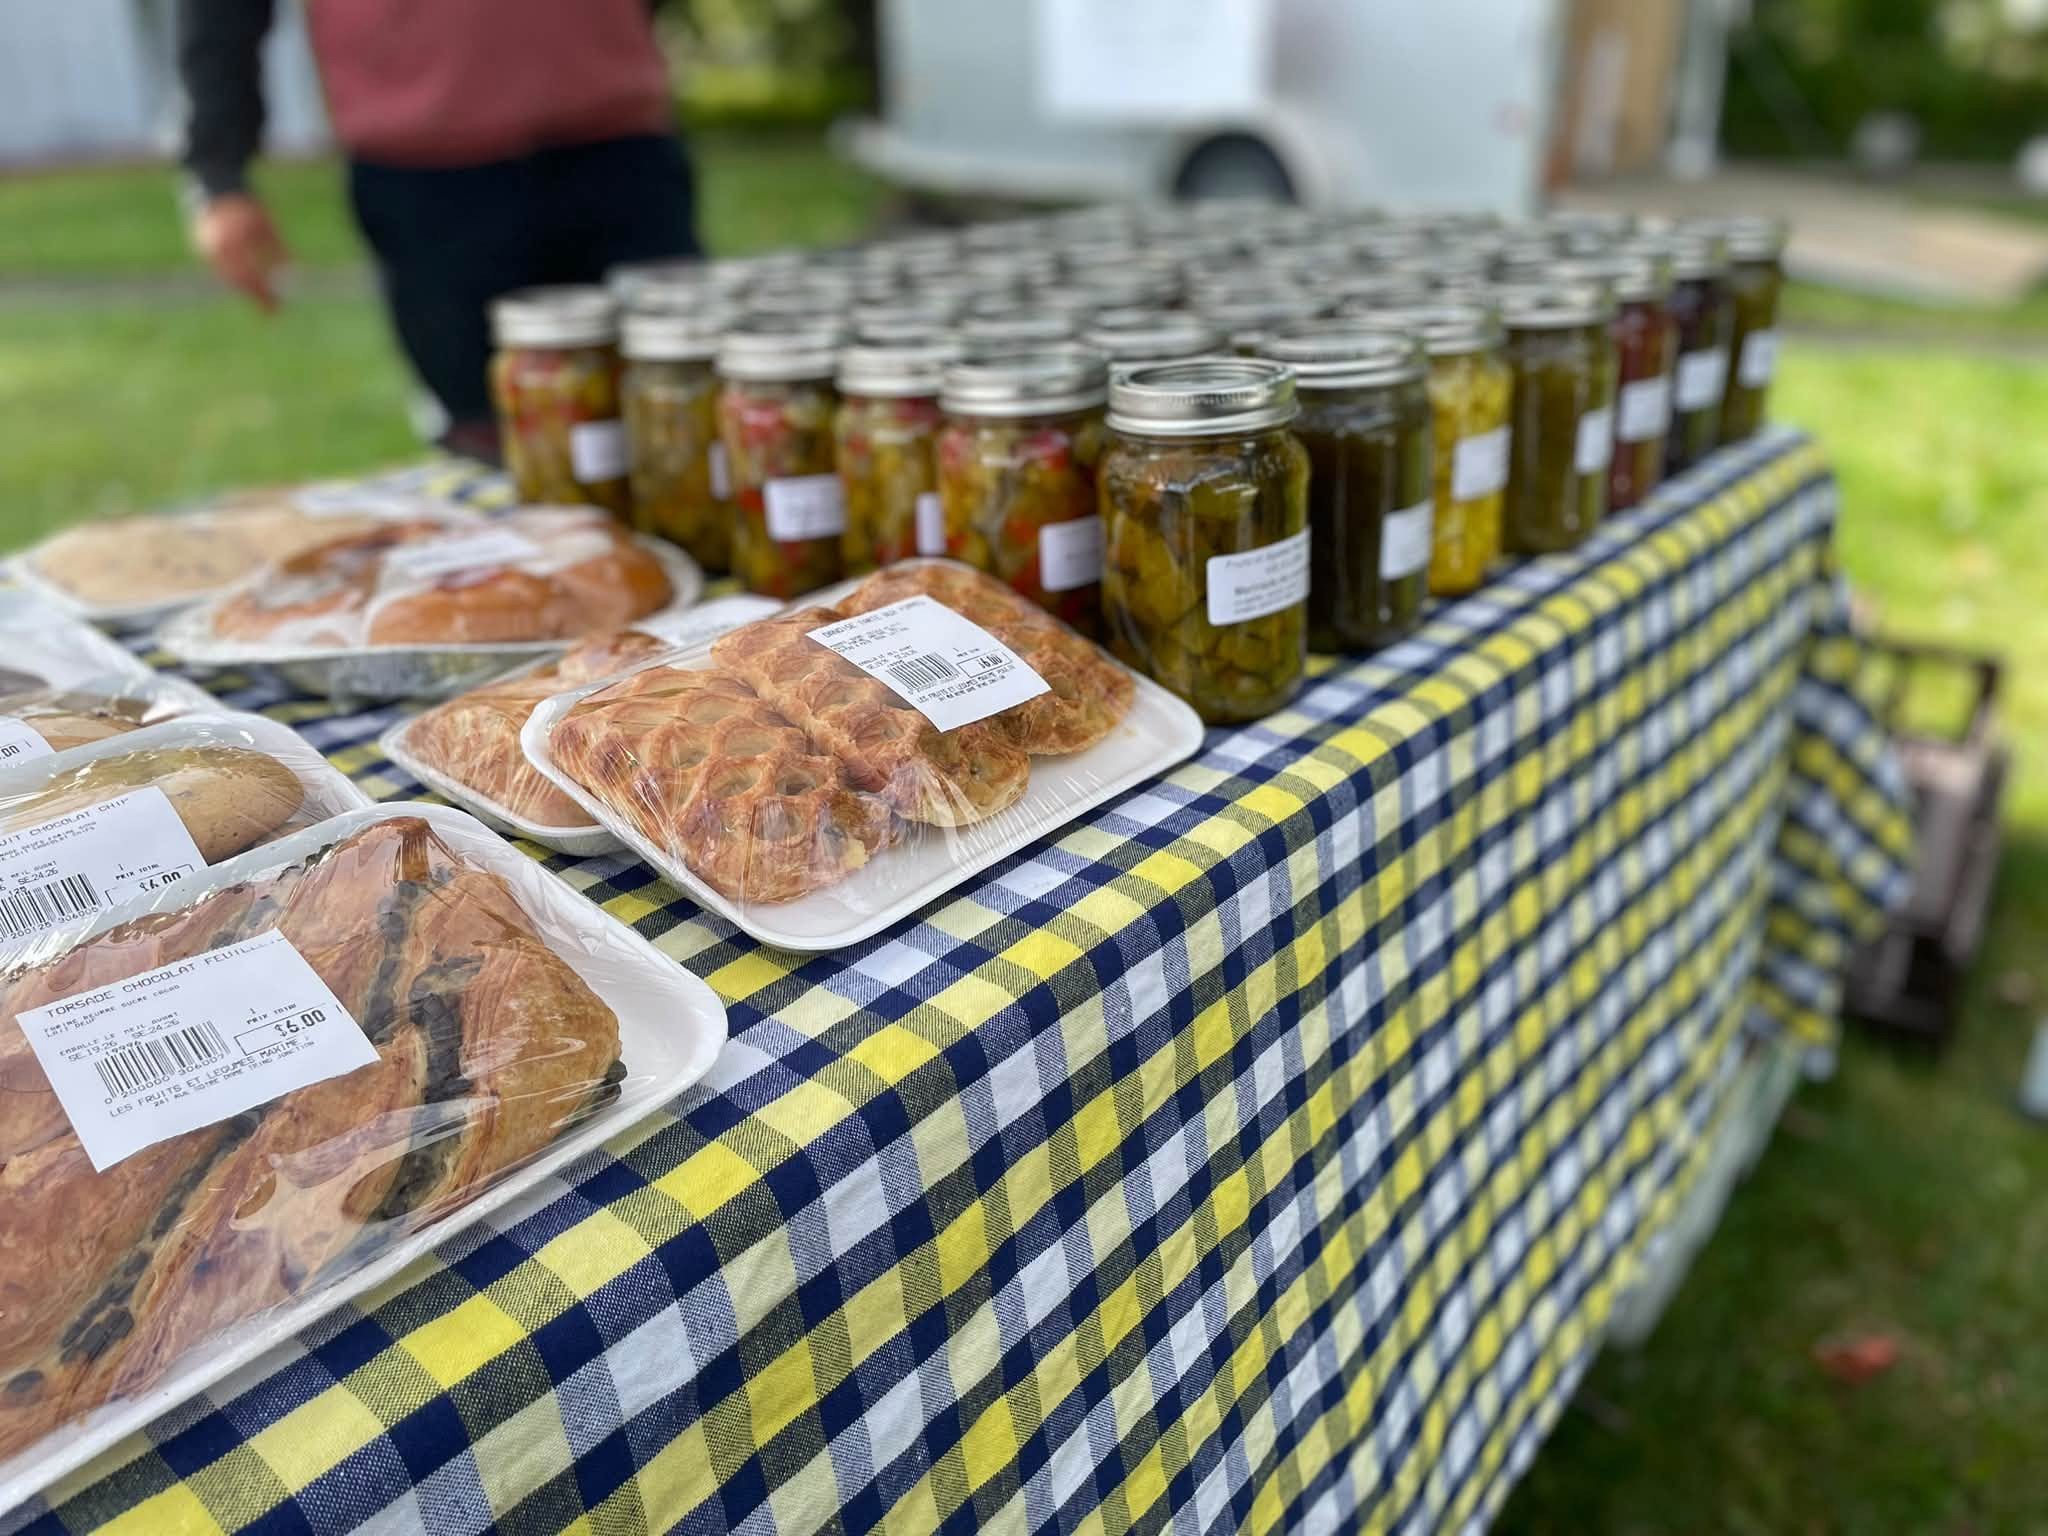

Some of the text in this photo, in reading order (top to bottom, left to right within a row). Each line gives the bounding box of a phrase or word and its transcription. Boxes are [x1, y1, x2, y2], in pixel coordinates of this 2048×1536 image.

[29, 811, 91, 837] CHOCOLAT
[46, 990, 115, 1019] TORSADE
[122, 962, 197, 994] CHOCOLAT
[274, 1009, 327, 1037] $6.00
[110, 1038, 299, 1118] LES FRUITS ET LEGUMES MAXIME
